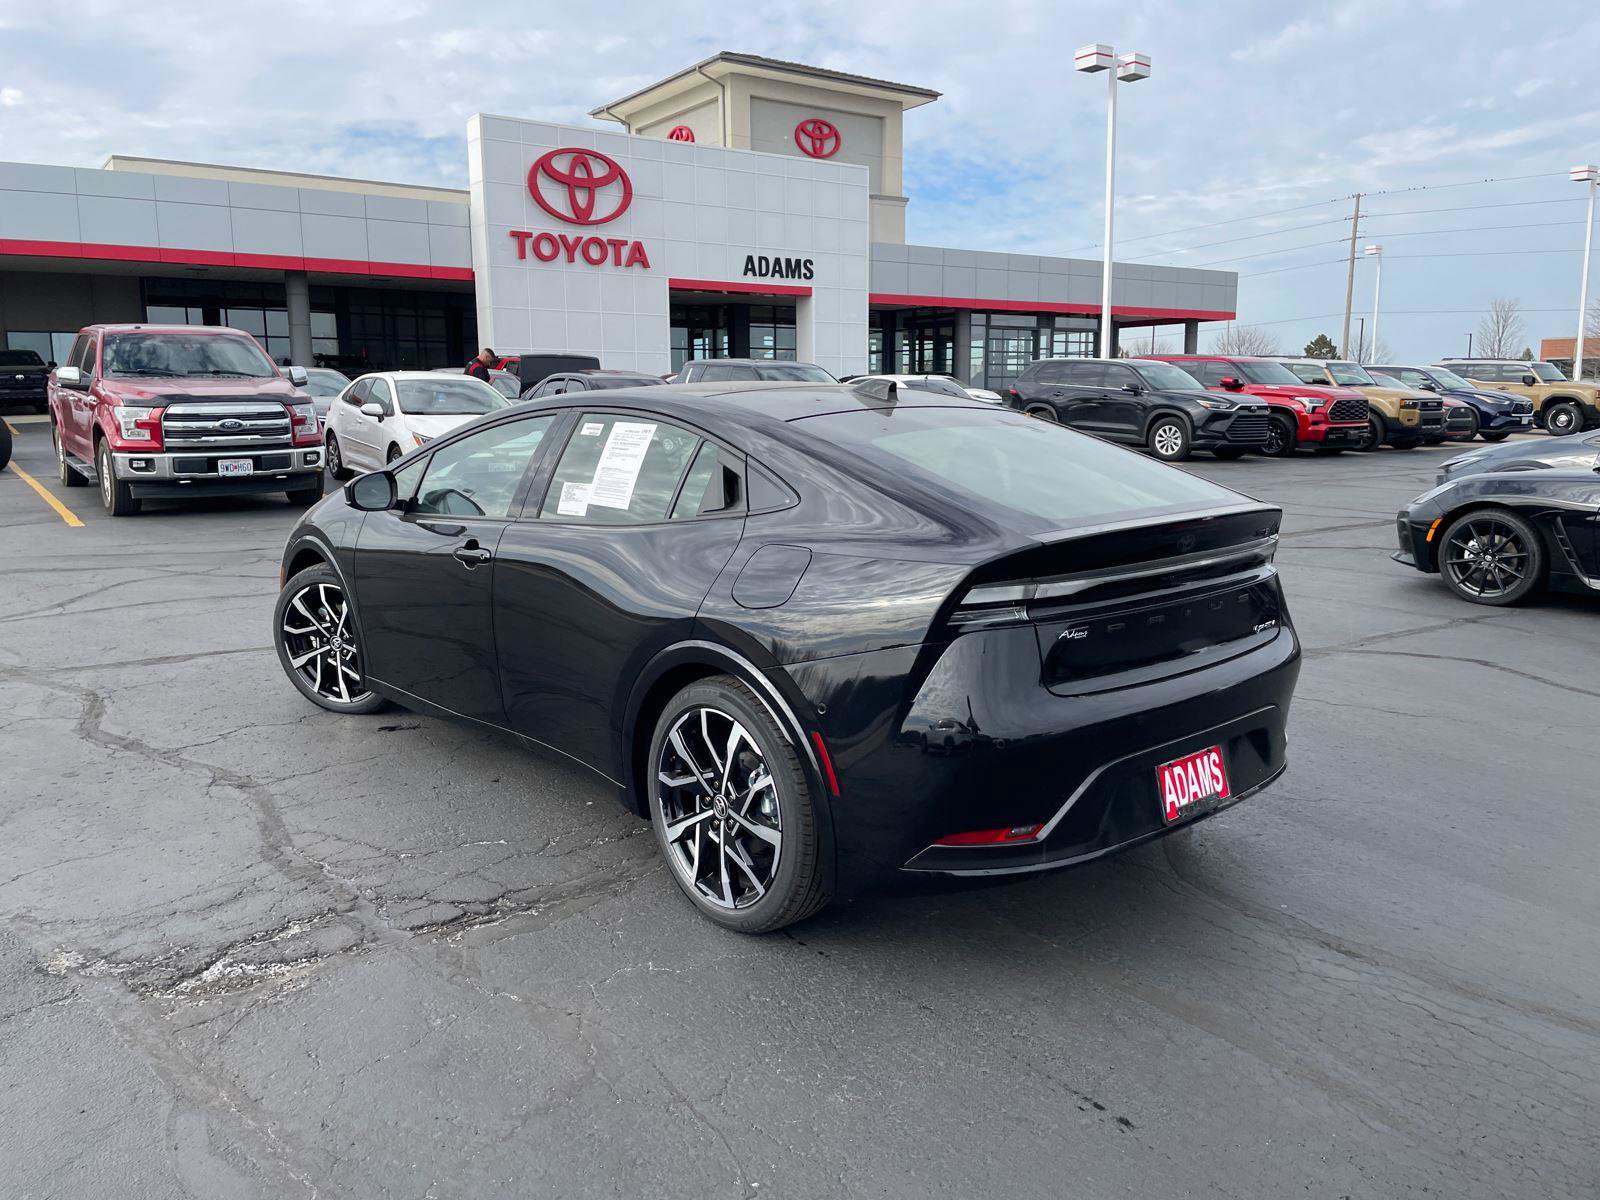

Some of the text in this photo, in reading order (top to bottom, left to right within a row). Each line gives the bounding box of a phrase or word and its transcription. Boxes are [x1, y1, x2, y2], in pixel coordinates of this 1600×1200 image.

[509, 230, 650, 268] TOYOTA
[743, 255, 814, 280] ADAMS
[1164, 752, 1223, 813] ADAMS
